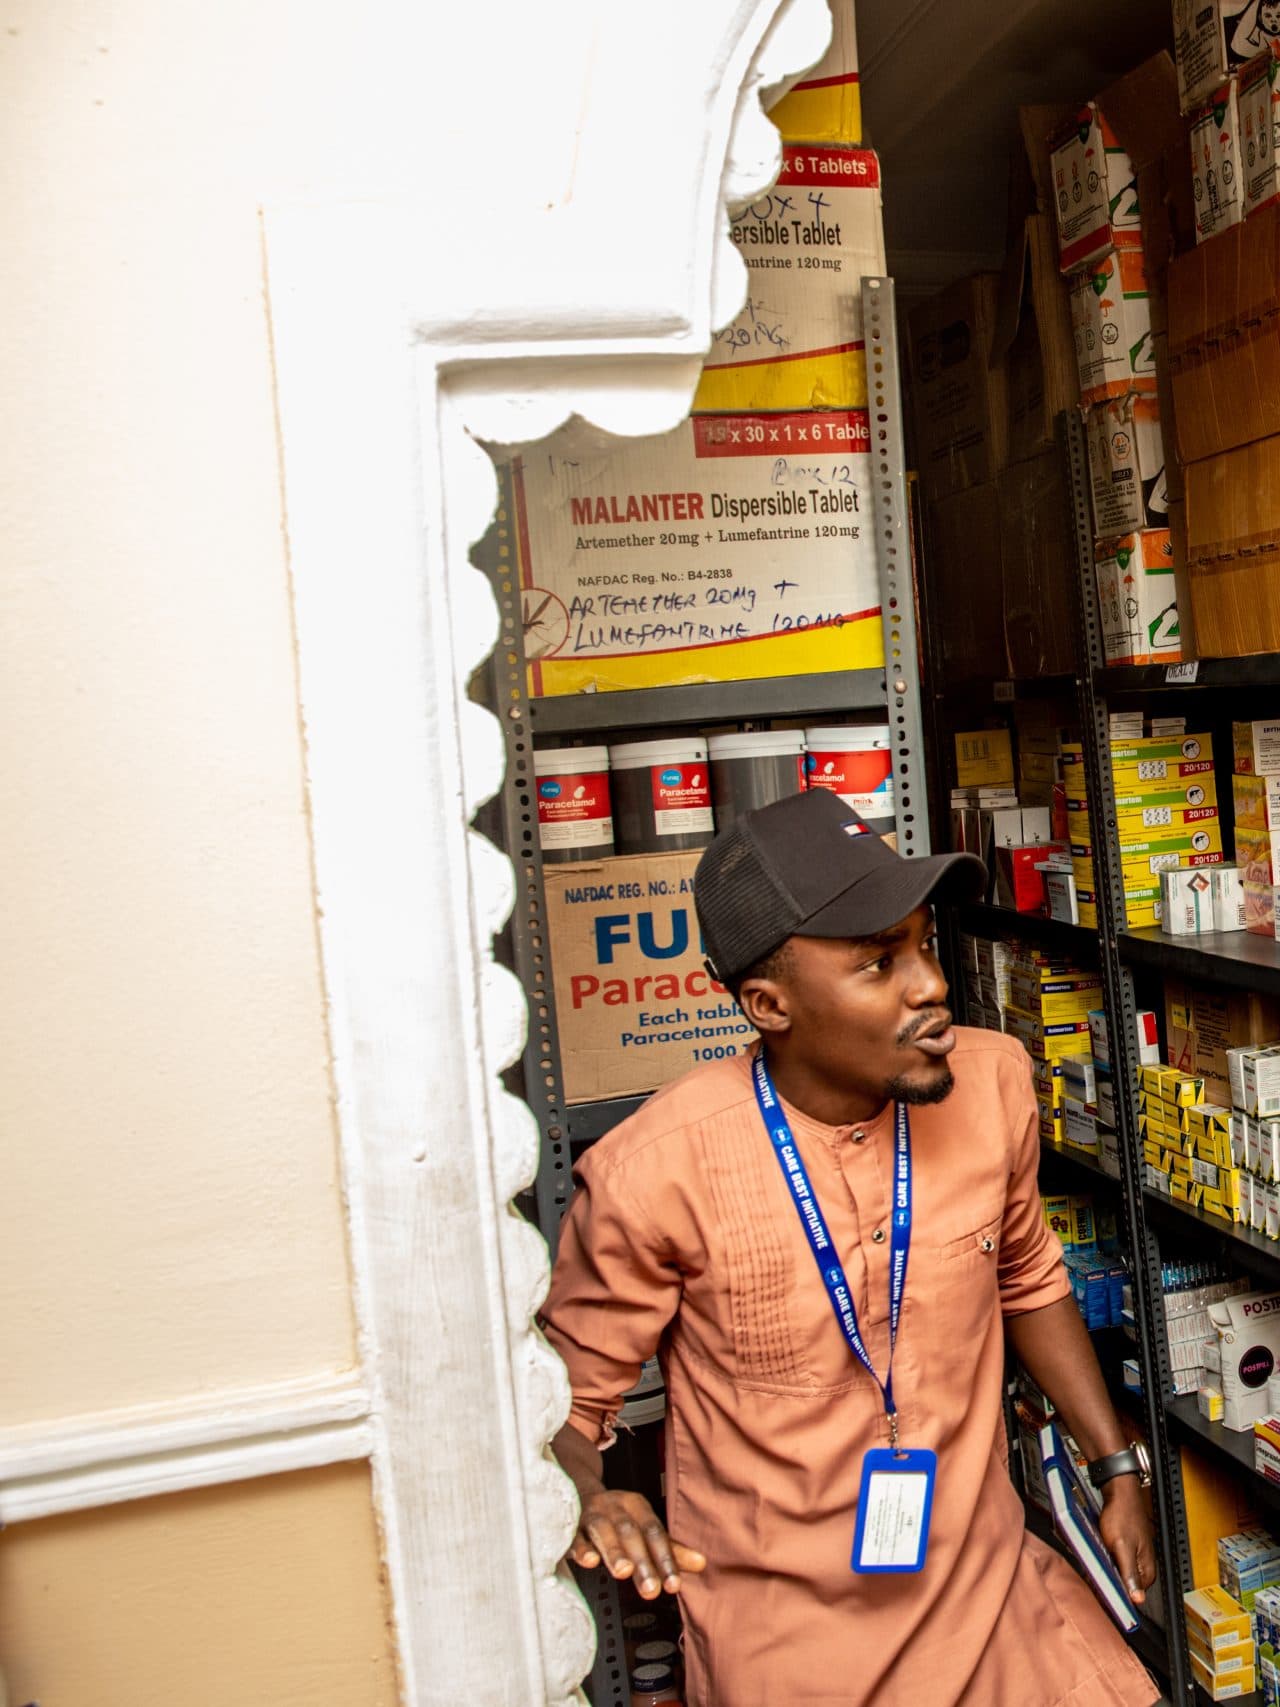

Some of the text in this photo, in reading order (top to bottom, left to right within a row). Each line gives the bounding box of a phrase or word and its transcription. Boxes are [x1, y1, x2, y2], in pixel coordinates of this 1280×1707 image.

[795, 157, 805, 173] 6
[808, 157, 868, 175] Tablets
[729, 220, 842, 246] ersible Tablet
[731, 430, 741, 443] x
[745, 426, 764, 442] 30
[769, 429, 779, 441] x
[784, 425, 792, 441] 1
[798, 428, 808, 441] x
[812, 424, 822, 440] 6
[570, 489, 859, 526] MALANTER Dispersible Tablet
[575, 533, 656, 550] Artemether
[704, 532, 713, 542] +
[718, 527, 810, 542] Lumefantrine
[578, 574, 629, 587] NAFDAC
[632, 573, 658, 585] Reg.
[688, 569, 733, 581] B4-2838
[1184, 762, 1211, 773] 20/120
[539, 797, 596, 810] Paracetamol
[1188, 809, 1214, 819] 20/120
[1193, 854, 1220, 865] 20/120
[565, 884, 615, 904] NAFDAC
[618, 882, 645, 899] REG.
[594, 909, 692, 965] FU
[639, 1008, 689, 1027] Each
[692, 1045, 737, 1061] 1000
[898, 1151, 908, 1179] BEST
[781, 1145, 828, 1250] CARE BEST INITIATIVE
[897, 1181, 908, 1208] CARE
[893, 1250, 904, 1298] INITIATIVE
[834, 1286, 850, 1314] CARE
[842, 1309, 856, 1336] BEST
